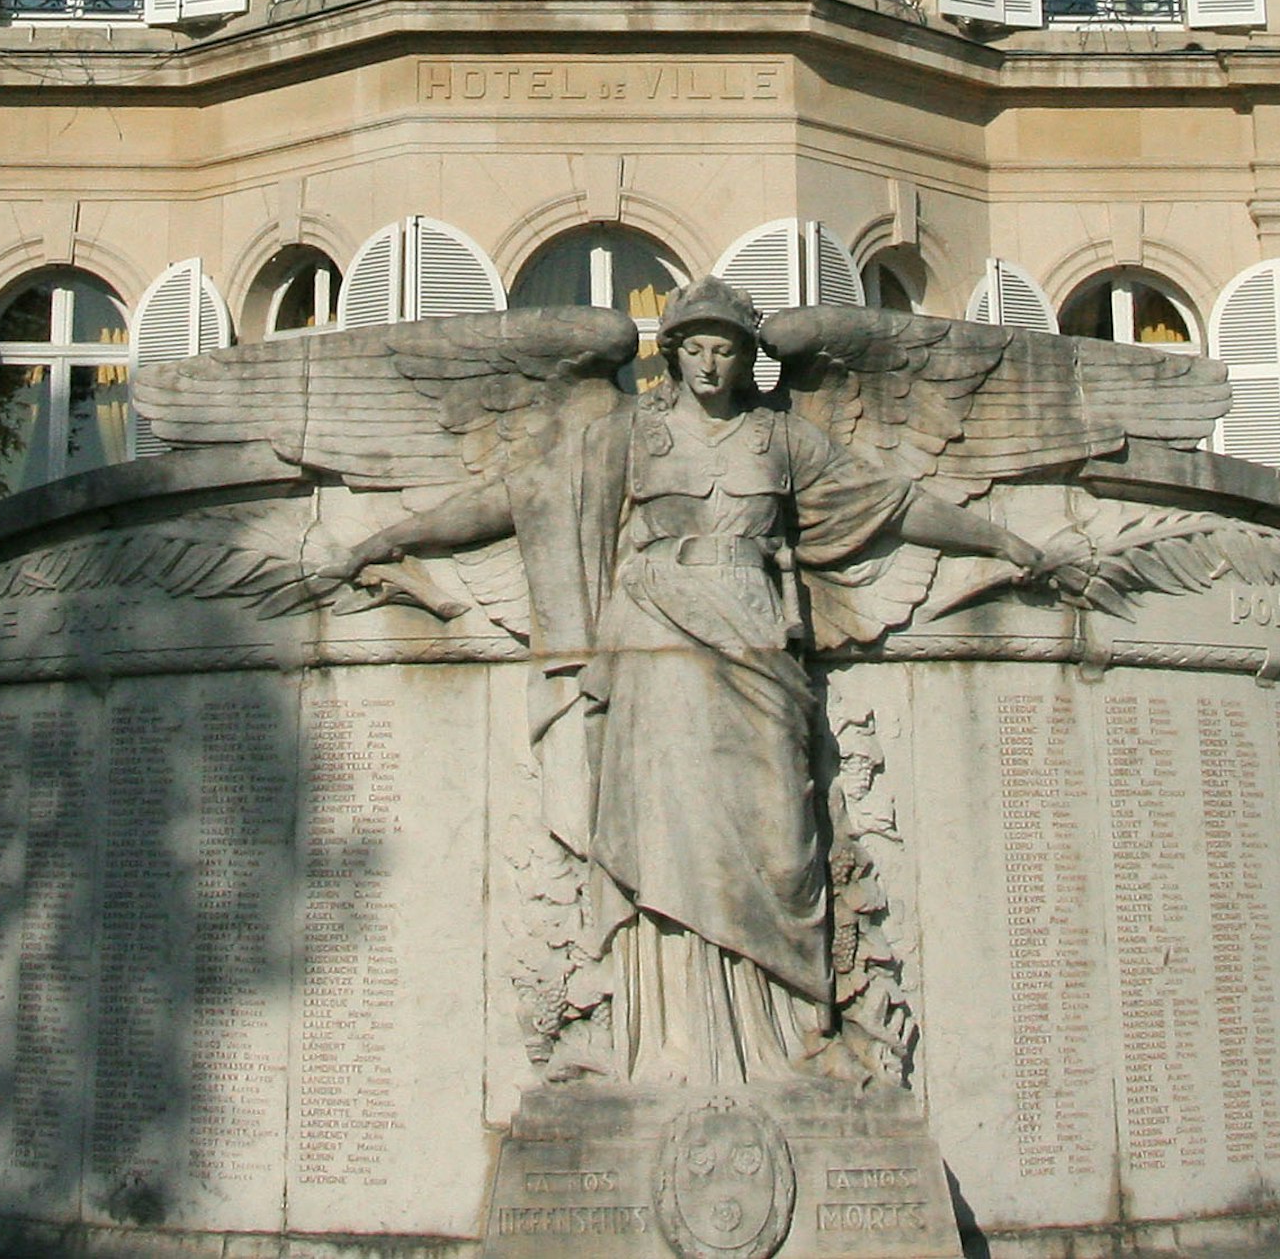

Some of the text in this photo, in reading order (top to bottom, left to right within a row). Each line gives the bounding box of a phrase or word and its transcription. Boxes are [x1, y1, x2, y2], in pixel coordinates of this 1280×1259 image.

[425, 67, 779, 101] HOTEL DE VILLE
[837, 1169, 918, 1189] A NOS
[820, 1203, 927, 1231] MORTS
